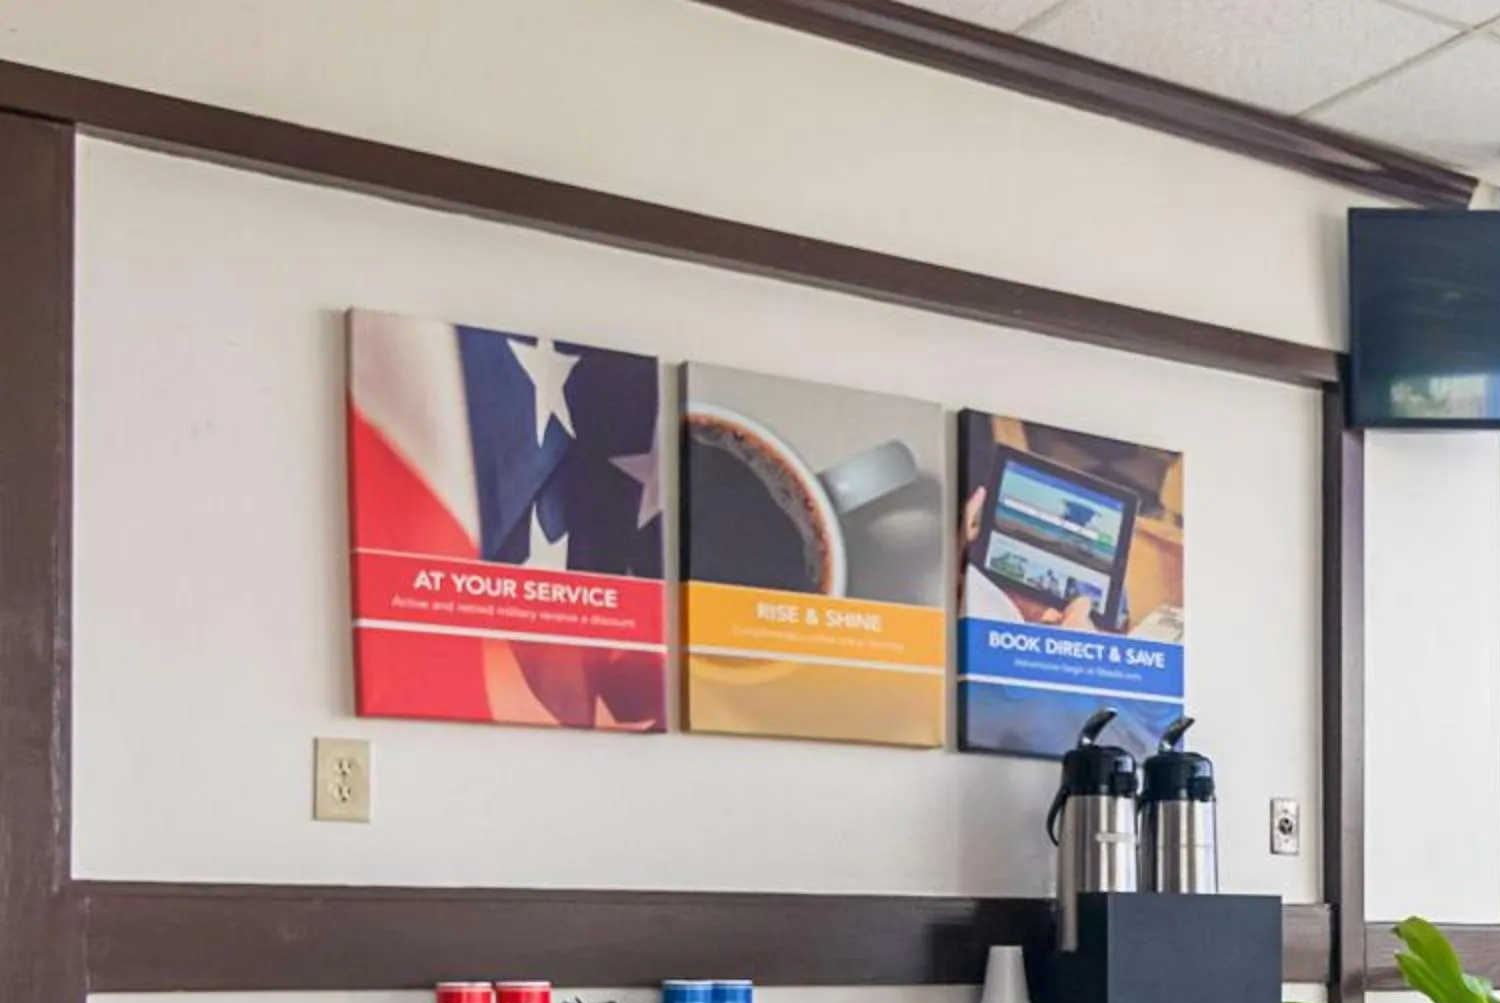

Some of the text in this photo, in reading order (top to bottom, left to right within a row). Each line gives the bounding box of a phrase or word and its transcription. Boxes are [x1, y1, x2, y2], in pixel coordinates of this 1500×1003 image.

[413, 570, 618, 608] AT YOUR SERVICE
[756, 602, 882, 633] RISE & SHINE
[989, 630, 1165, 669] BOOK DIRECT & SAVE
